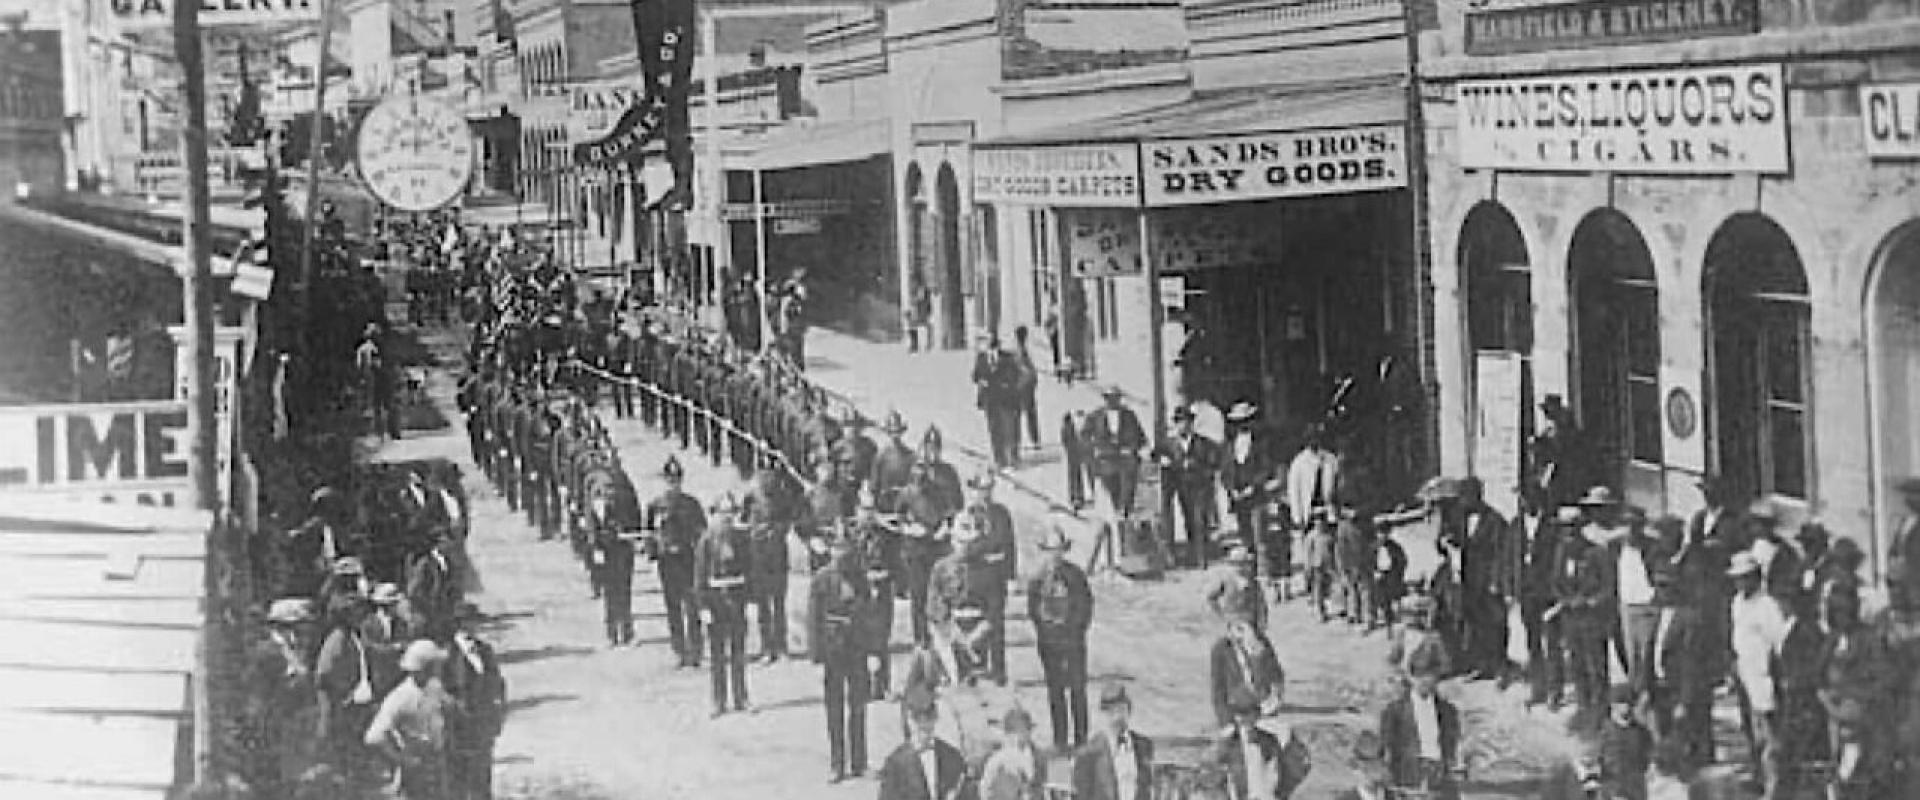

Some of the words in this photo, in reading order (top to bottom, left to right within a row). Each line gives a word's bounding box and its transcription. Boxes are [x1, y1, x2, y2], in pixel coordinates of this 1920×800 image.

[1869, 91, 1920, 142] CL
[1153, 141, 1279, 168] SANDS
[1163, 168, 1245, 193] DRY
[1266, 158, 1396, 184] GOODS.
